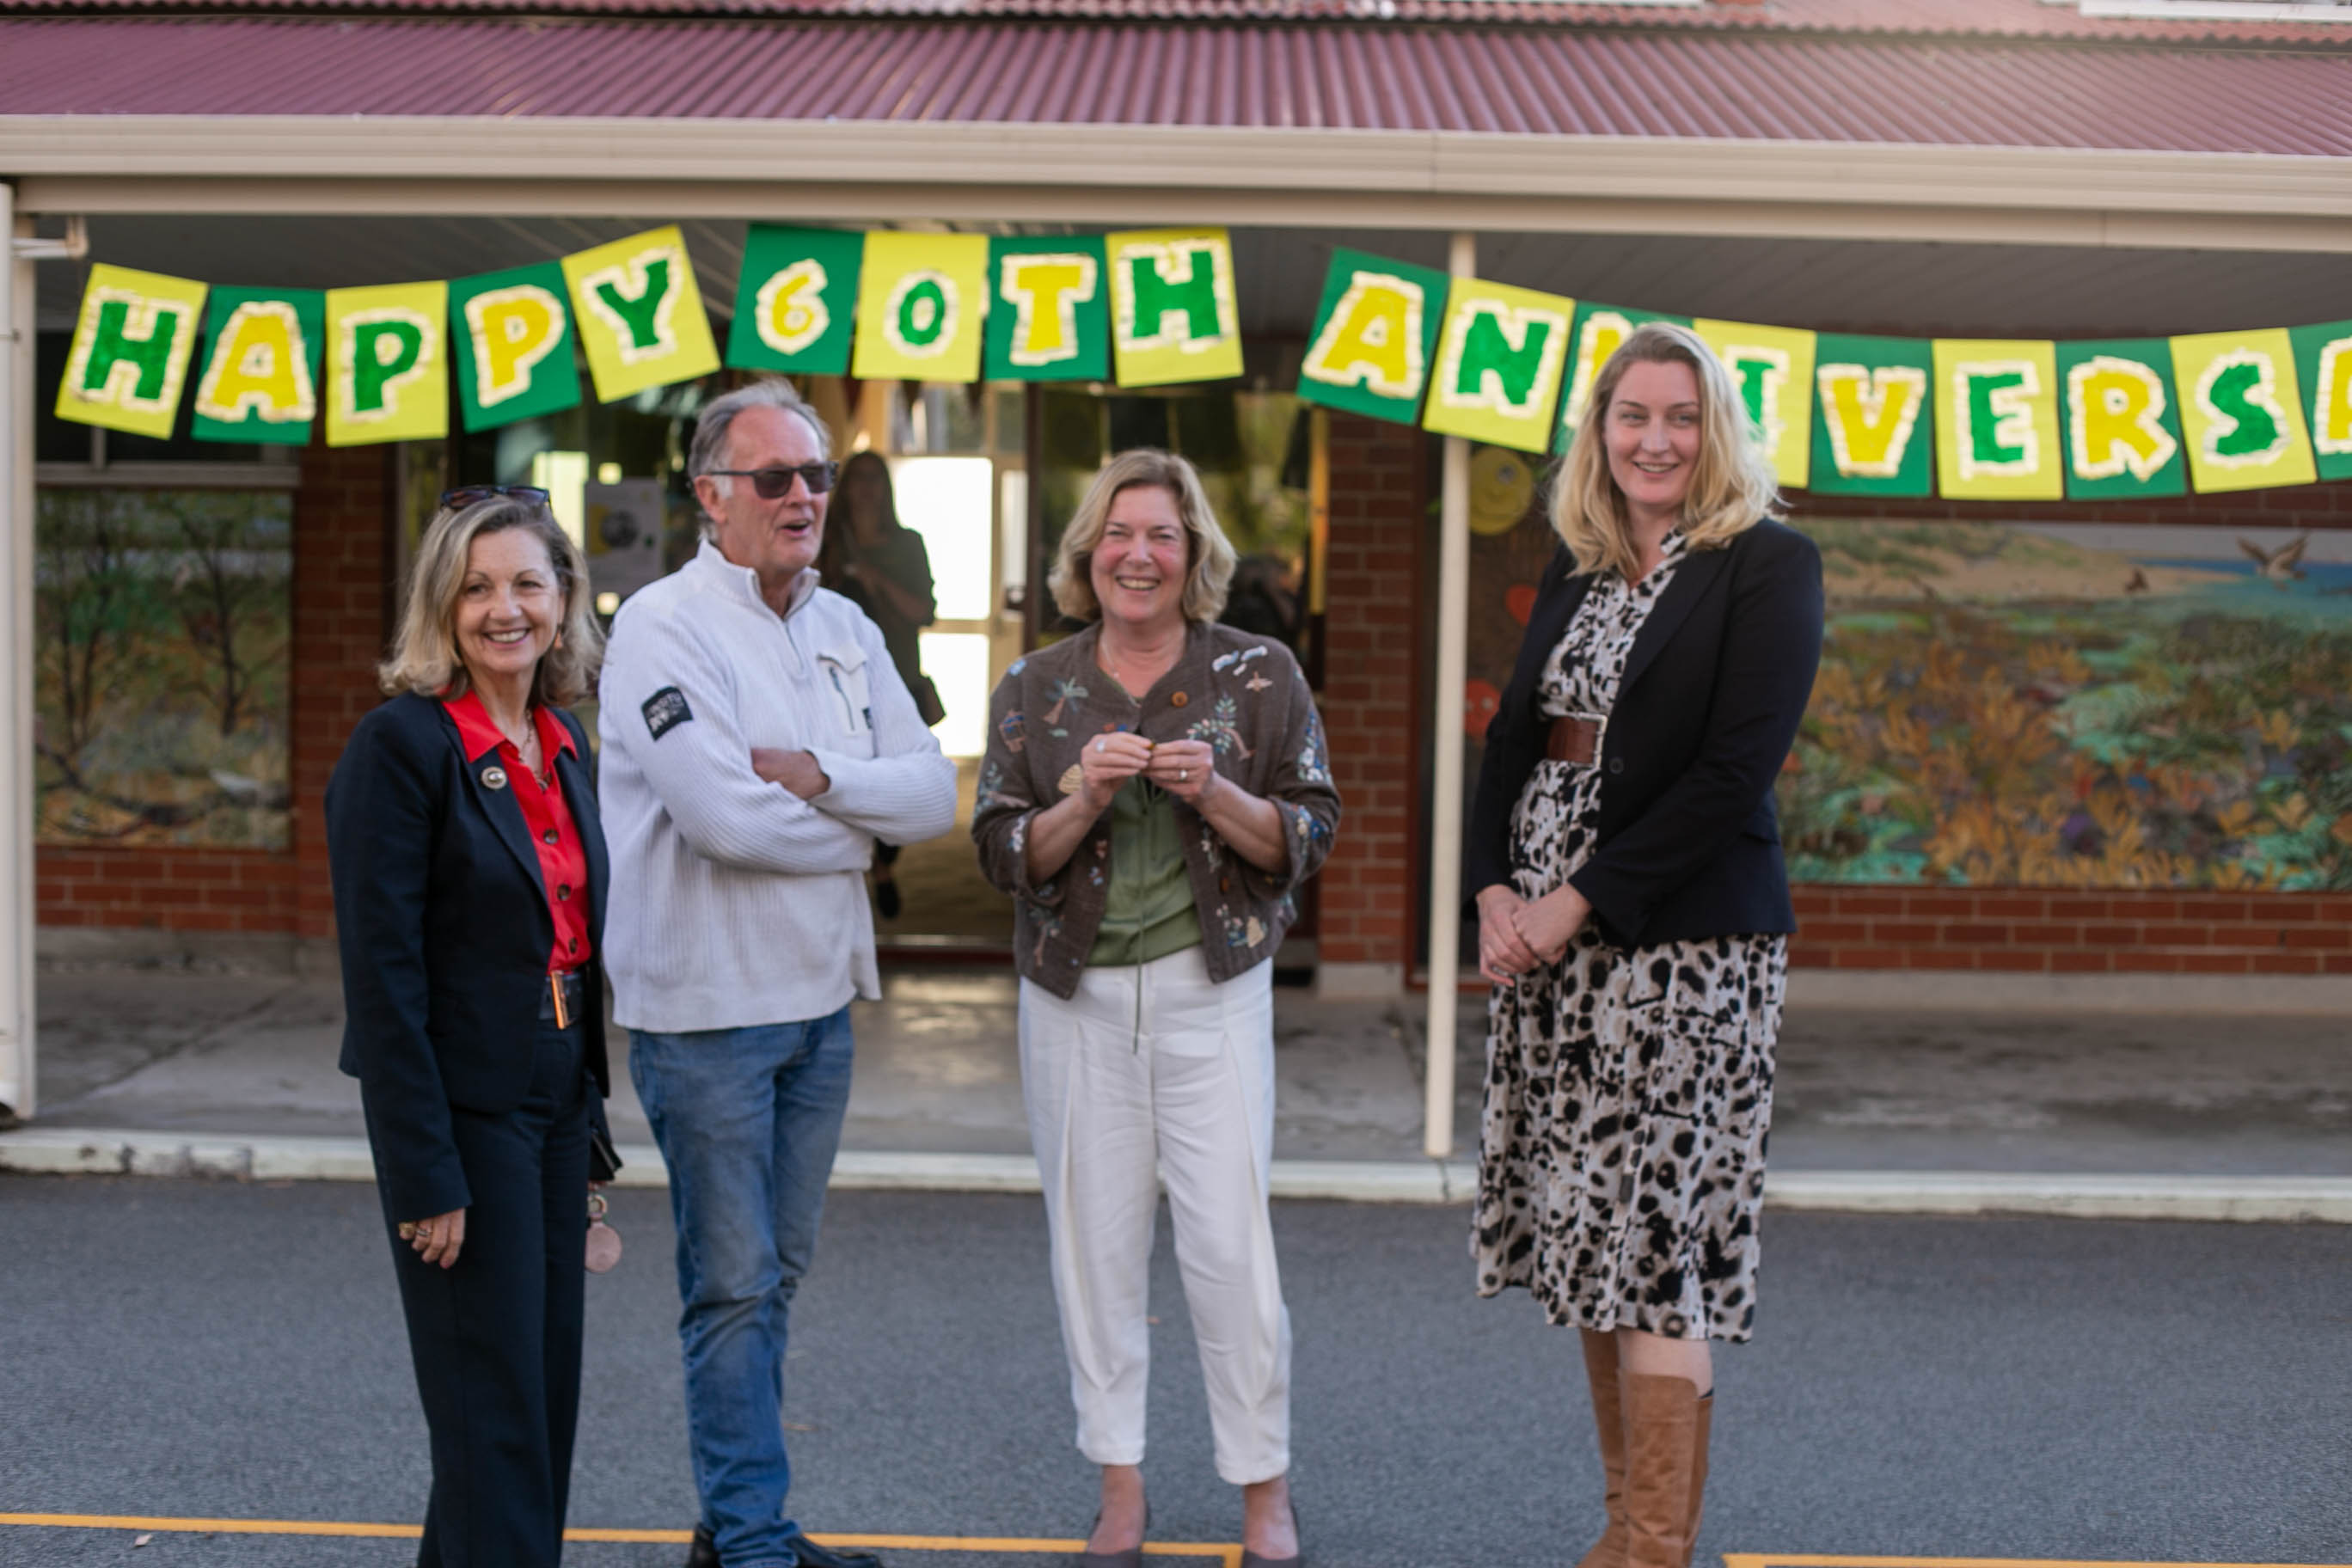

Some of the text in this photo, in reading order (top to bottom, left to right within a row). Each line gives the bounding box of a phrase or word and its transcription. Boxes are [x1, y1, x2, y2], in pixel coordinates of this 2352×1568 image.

[70, 236, 2352, 481] HAPPY 60TH ANIVERS
